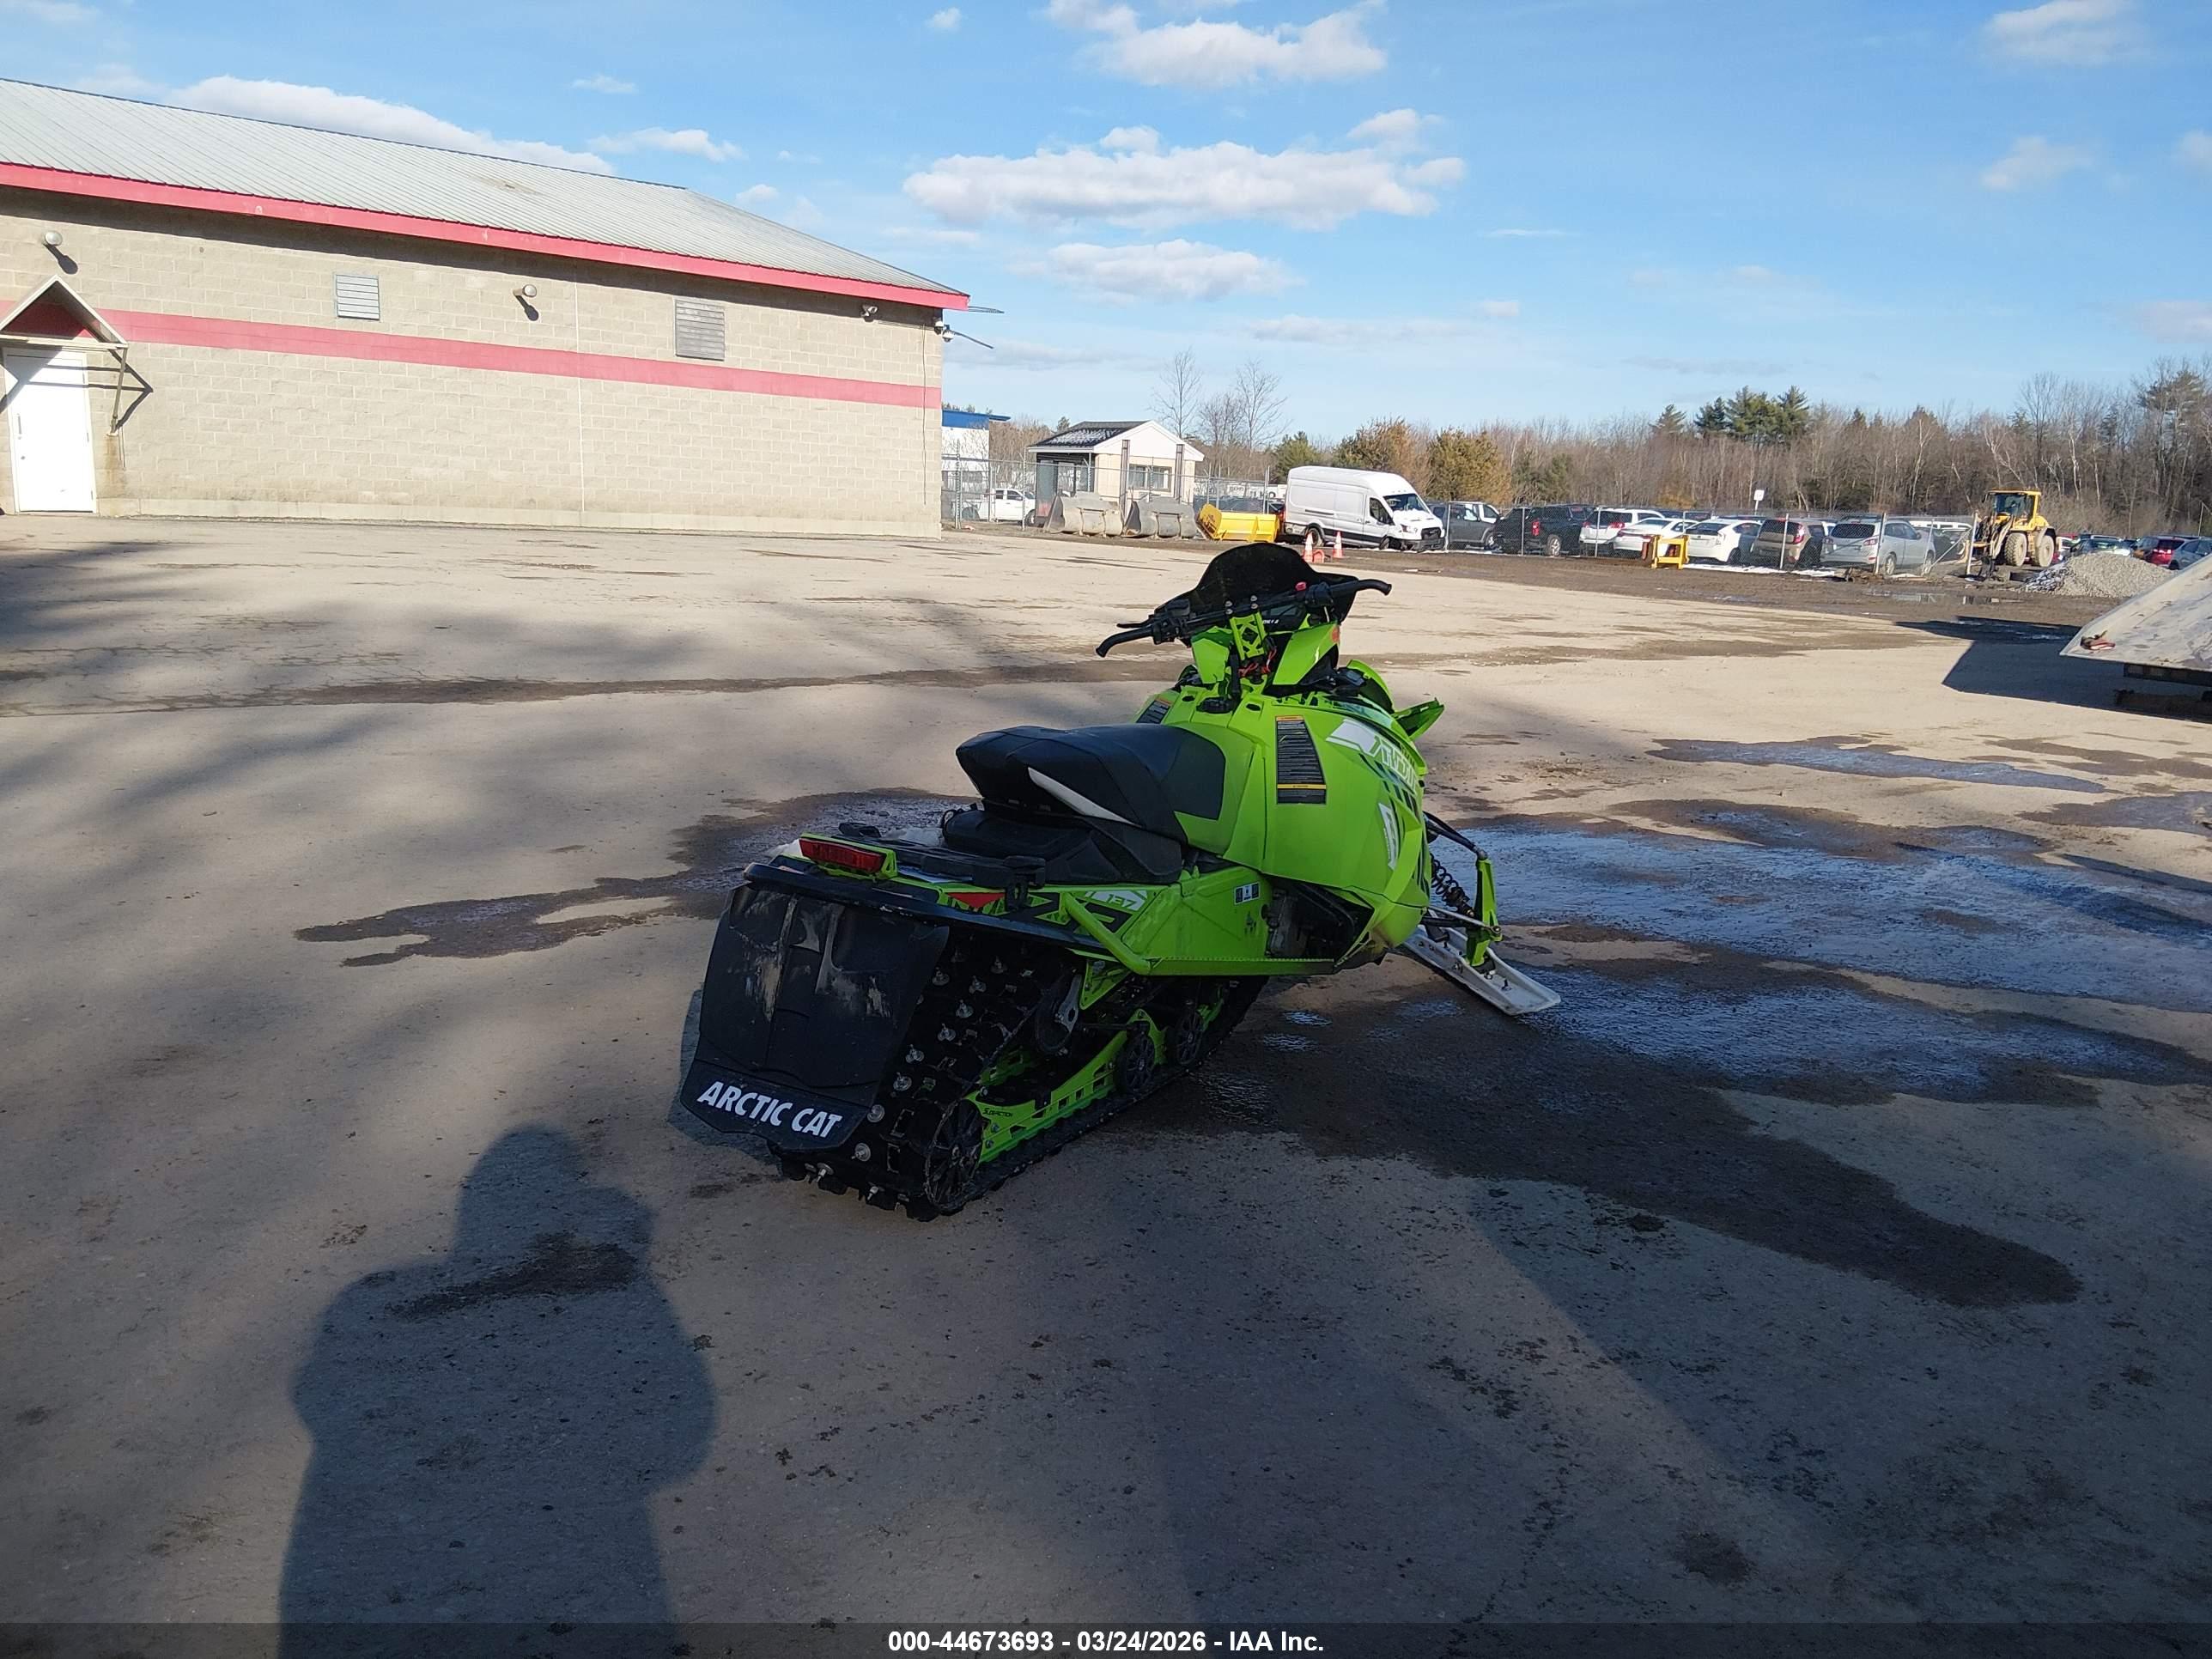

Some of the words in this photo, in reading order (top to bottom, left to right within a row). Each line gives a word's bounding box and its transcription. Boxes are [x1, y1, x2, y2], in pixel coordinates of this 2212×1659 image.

[1105, 893, 1138, 908] 137
[696, 1081, 793, 1127] ARCTIC
[791, 1108, 843, 1138] CAT
